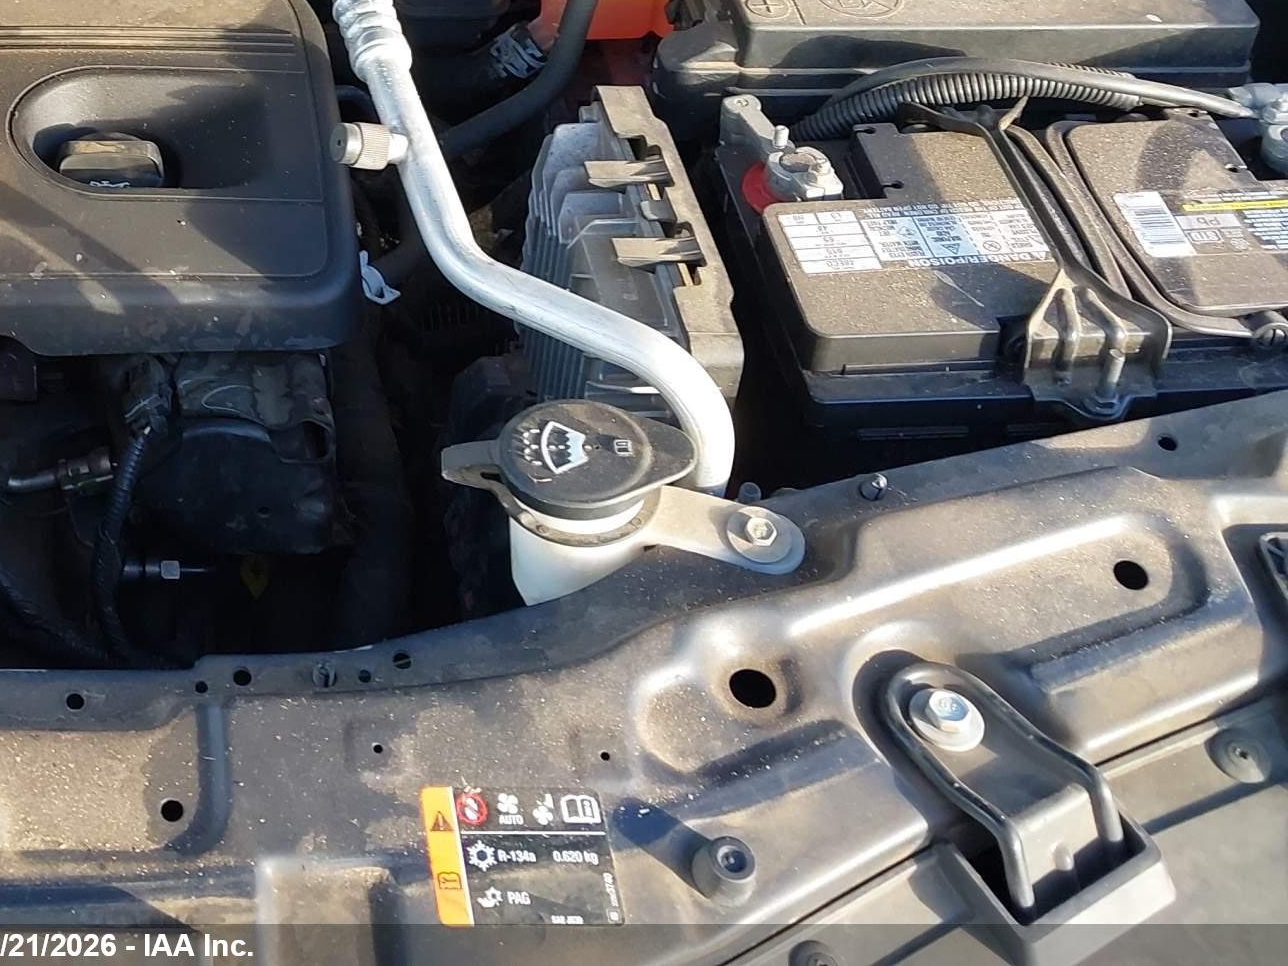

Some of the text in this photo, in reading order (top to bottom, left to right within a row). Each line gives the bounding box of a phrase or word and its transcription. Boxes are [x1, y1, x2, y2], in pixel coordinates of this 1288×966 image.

[908, 251, 1030, 268] DANGER/POISON
[499, 814, 524, 825] AUTO
[497, 848, 537, 862] R-134a
[583, 850, 600, 866] kg
[507, 891, 532, 905] PAG
